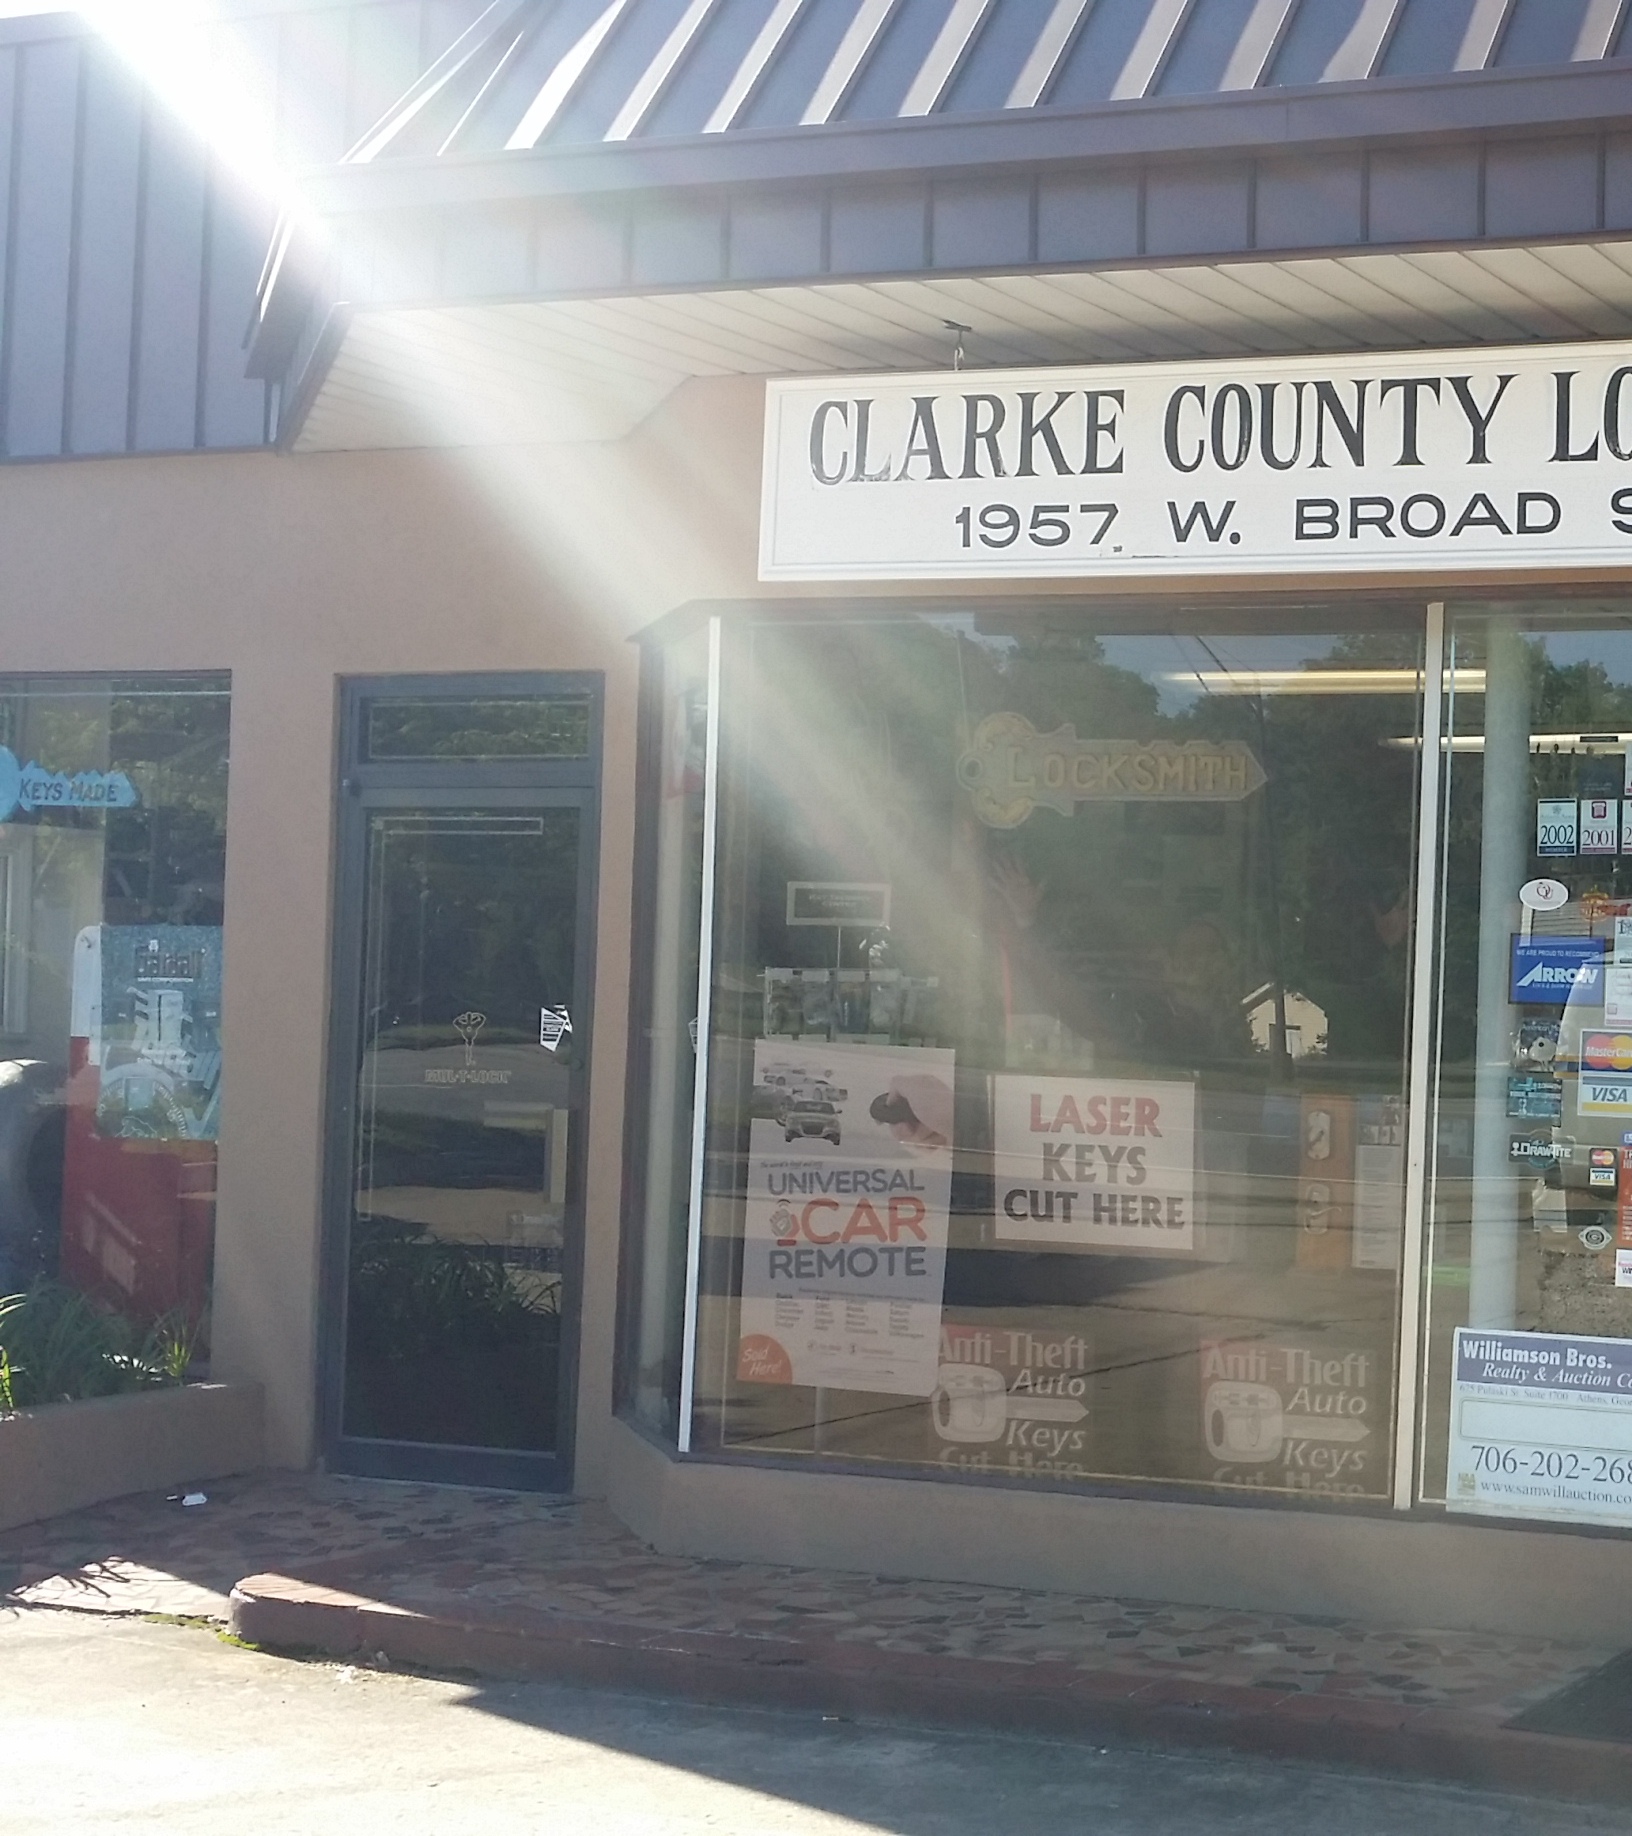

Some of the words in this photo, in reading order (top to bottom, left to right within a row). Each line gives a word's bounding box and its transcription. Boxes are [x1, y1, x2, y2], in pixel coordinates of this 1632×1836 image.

[809, 389, 1126, 486] CLARKE
[1164, 373, 1520, 474] COUNTY
[955, 503, 1120, 549] 1957
[1167, 500, 1242, 546] W.
[1295, 491, 1562, 541] BROAD
[1008, 747, 1249, 791] LOCKSMITH
[1540, 824, 1575, 845] 2002
[1582, 829, 1615, 846] 2001
[1516, 961, 1599, 986] ARROW
[1591, 1086, 1629, 1103] VISA
[1029, 1093, 1163, 1138] LASER
[768, 1168, 926, 1196] UNIVERSAL
[1042, 1142, 1147, 1186] KEYS
[801, 1196, 928, 1245] CAR
[1004, 1189, 1079, 1224] CUT
[1093, 1193, 1186, 1230] HERE
[769, 1246, 928, 1279] REMOTE
[938, 1326, 1089, 1370] Anti-Theft
[1202, 1344, 1371, 1388] Anti-Theft
[1462, 1340, 1561, 1366] Williamson
[1566, 1347, 1613, 1370] Bros.
[1007, 1368, 1086, 1397] Auto
[1482, 1362, 1530, 1384] Realty
[1533, 1366, 1548, 1382] &
[1551, 1368, 1612, 1387] Auction
[1285, 1387, 1367, 1415] Auto
[1005, 1419, 1086, 1457] Keys
[1283, 1439, 1368, 1478] Keys
